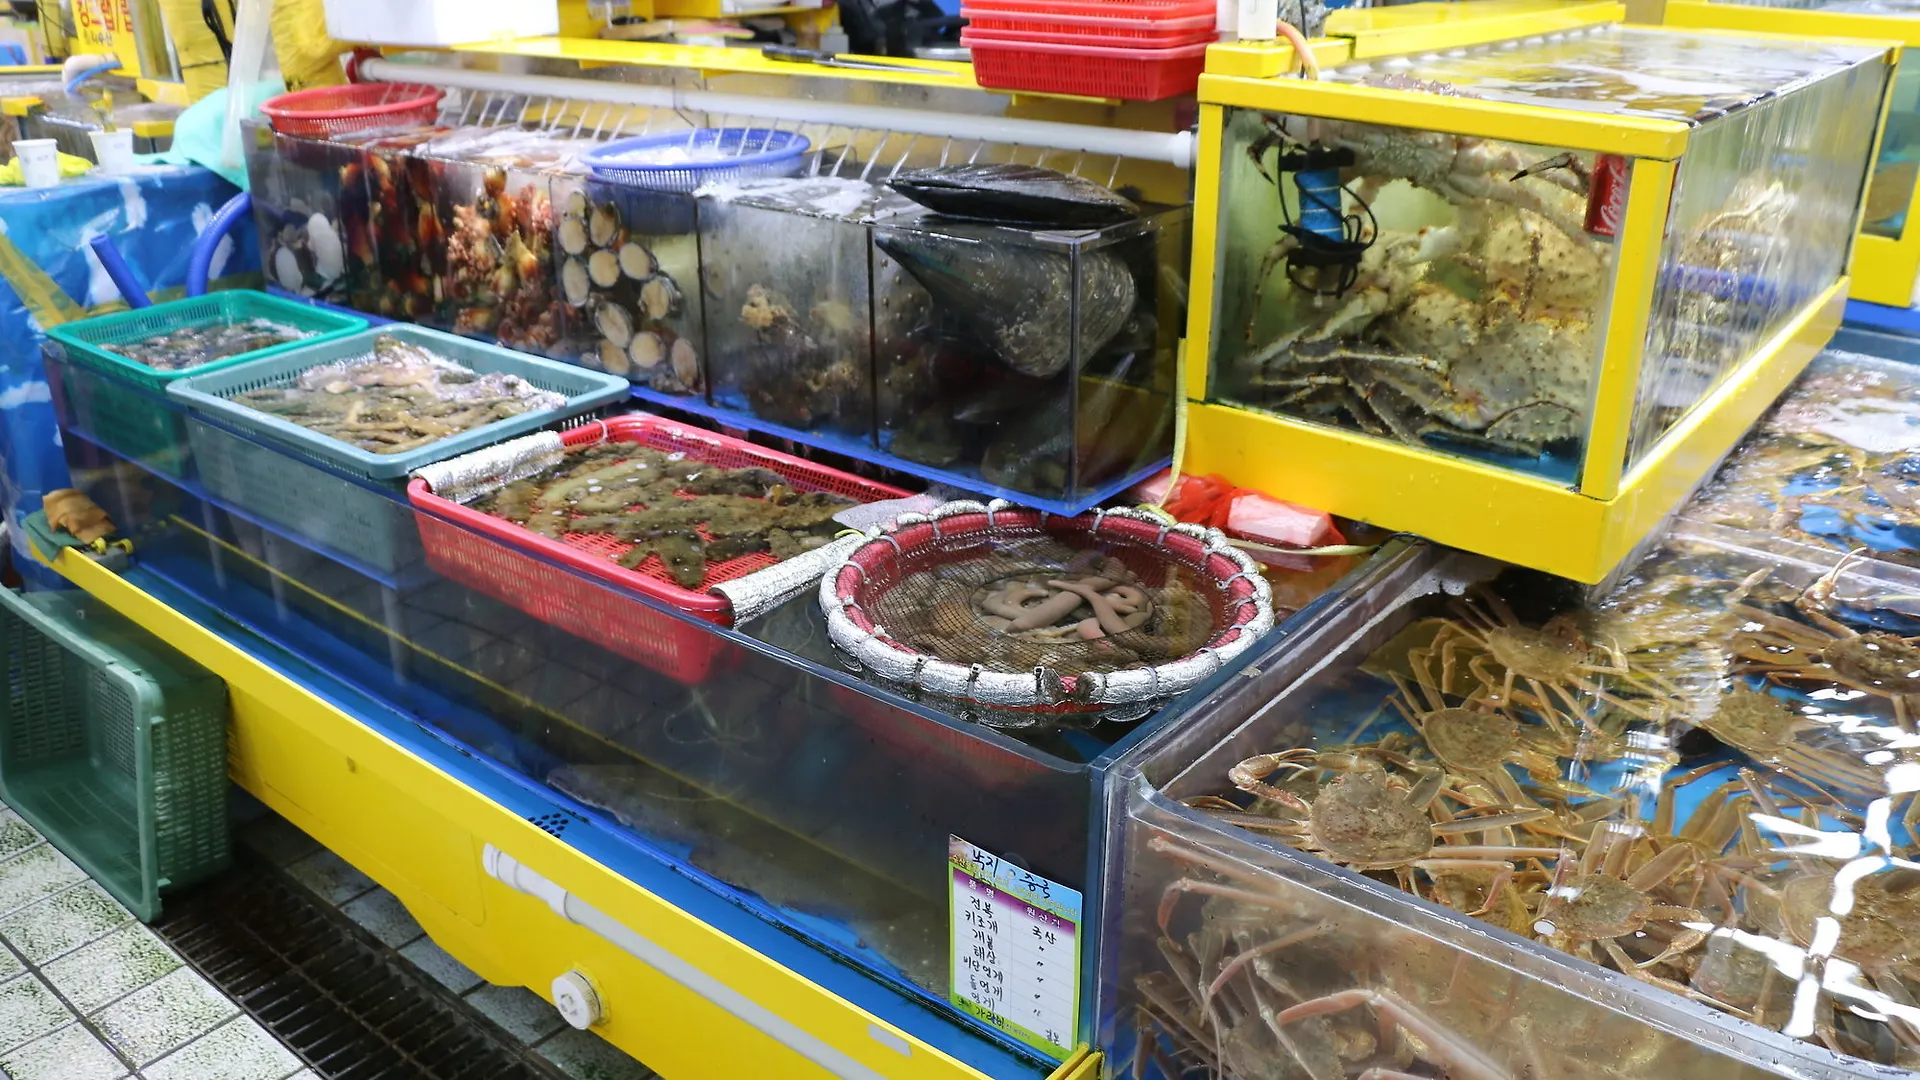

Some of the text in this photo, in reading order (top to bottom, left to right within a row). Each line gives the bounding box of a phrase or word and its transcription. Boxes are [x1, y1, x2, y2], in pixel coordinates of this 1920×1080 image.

[972, 849, 999, 877] 낙지
[970, 895, 994, 918] 전복
[965, 909, 998, 935] 키조개
[1032, 925, 1057, 945] 국산
[973, 945, 997, 965] 해삼
